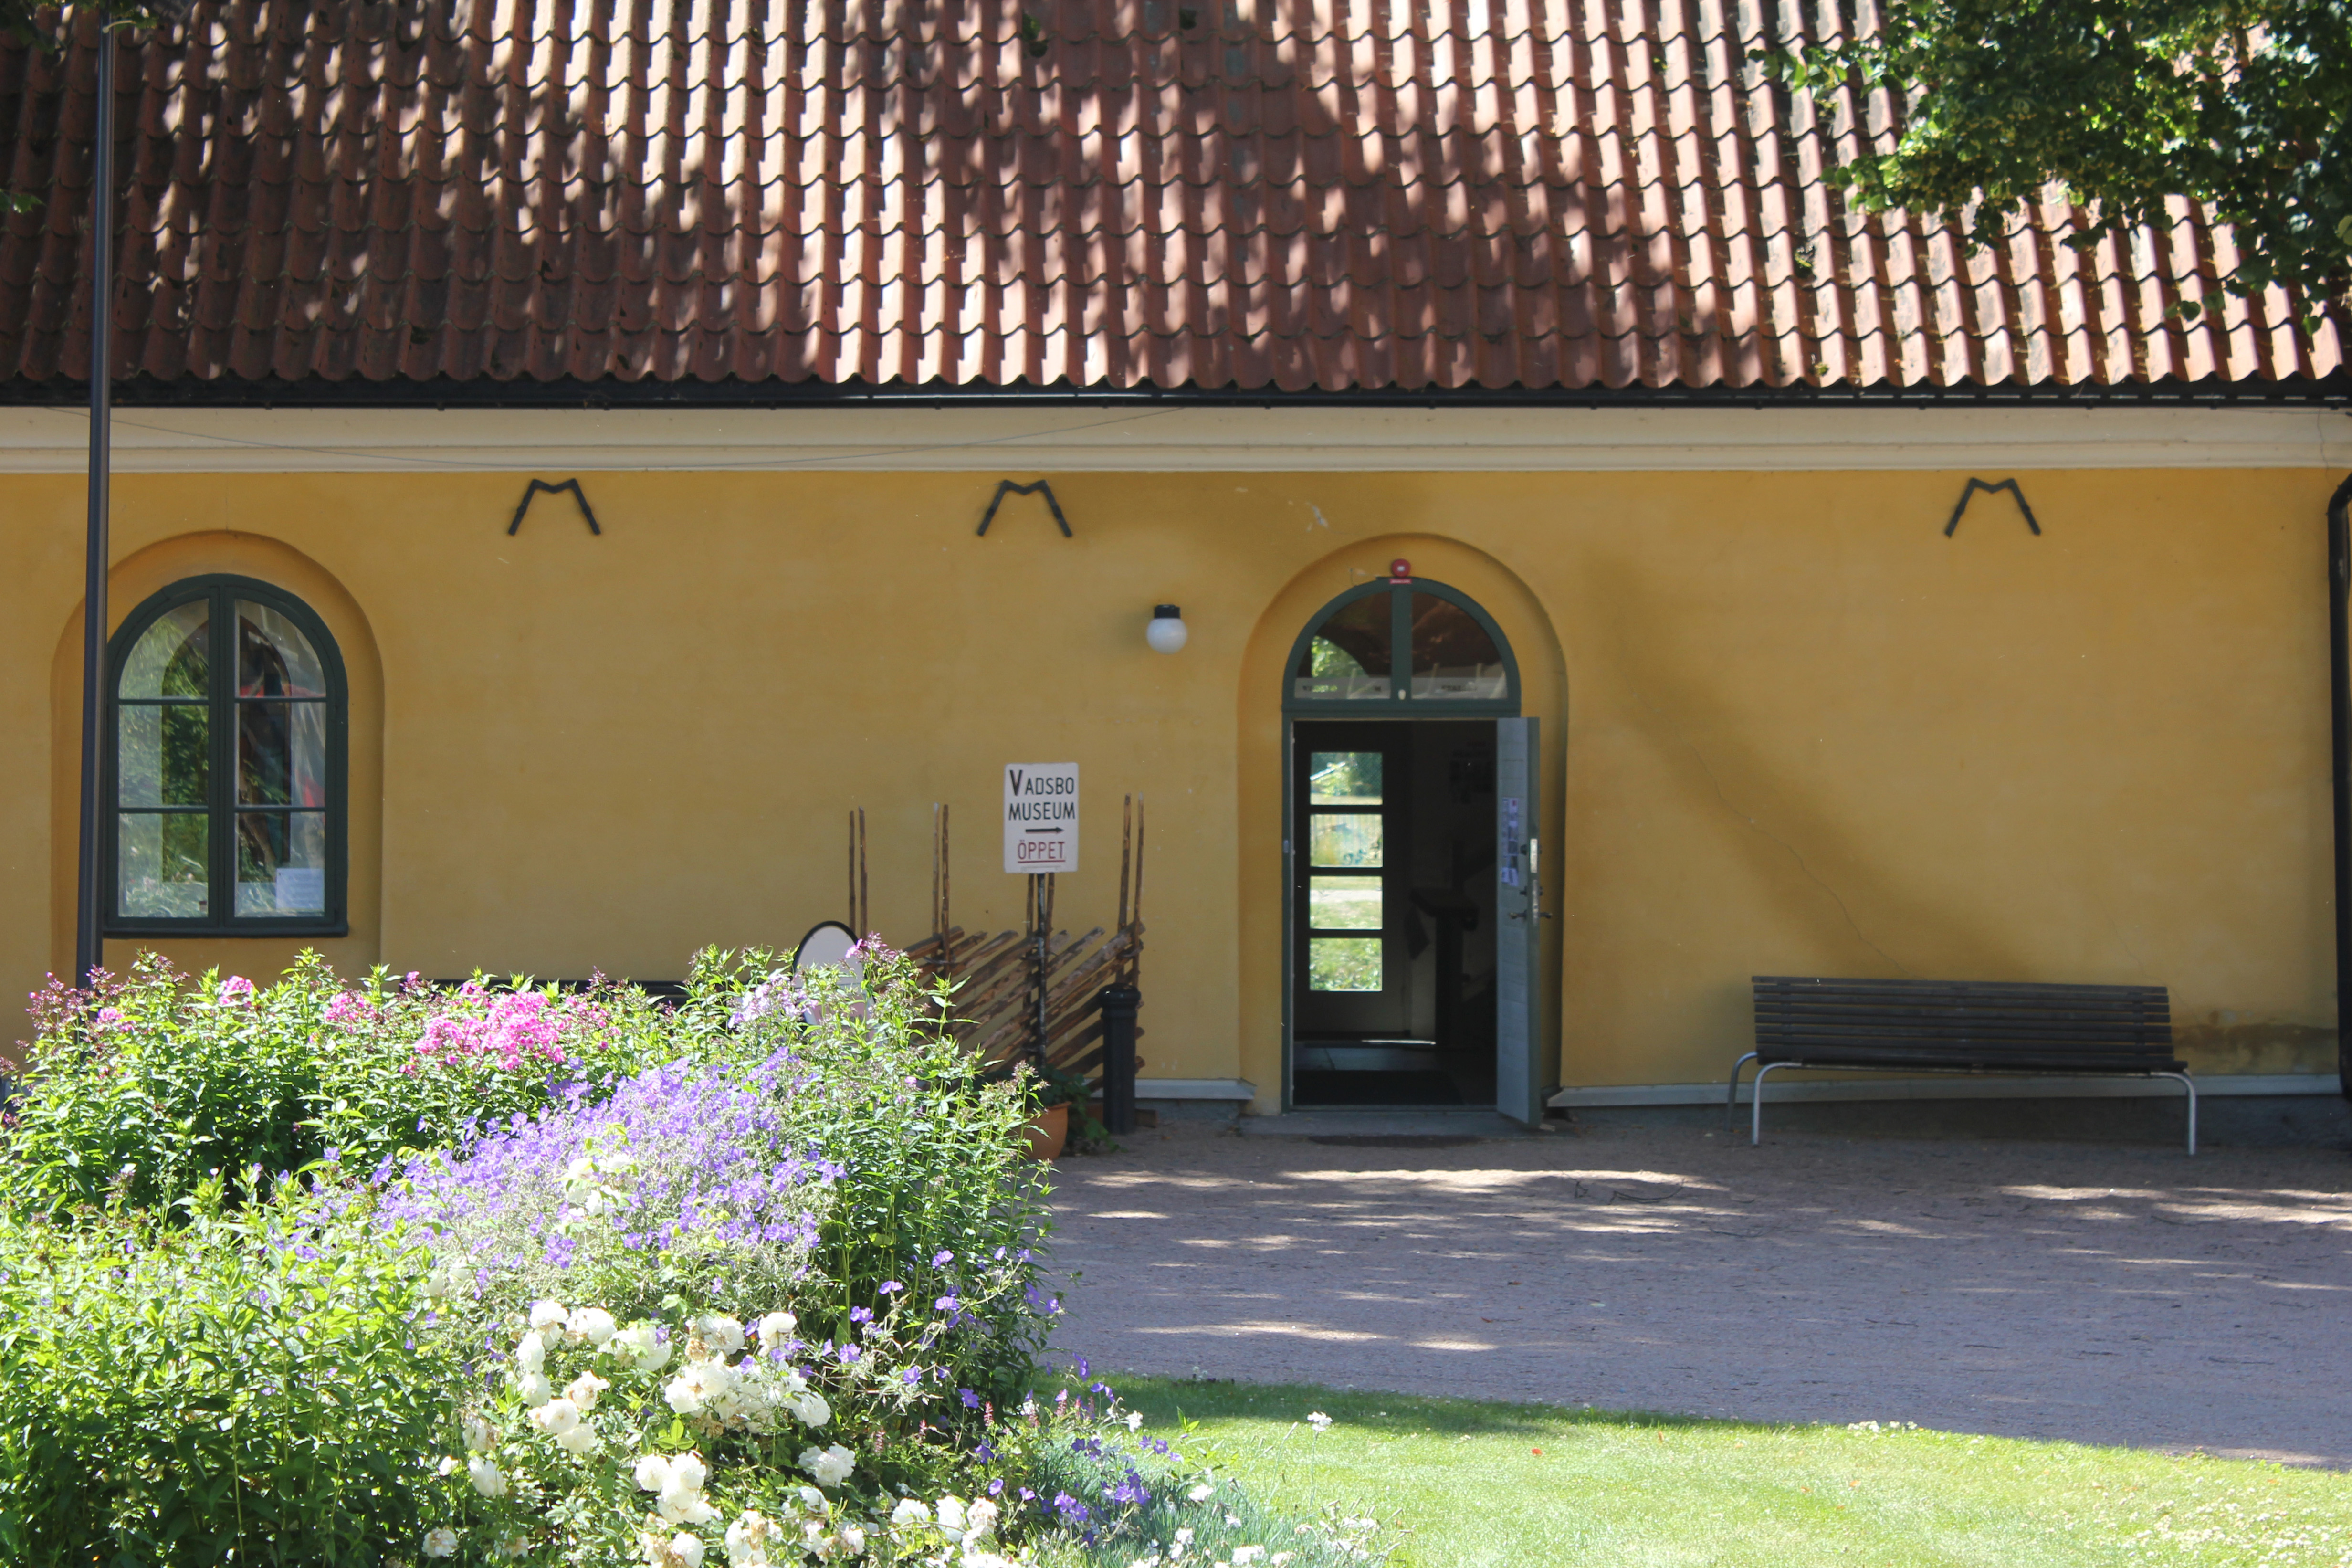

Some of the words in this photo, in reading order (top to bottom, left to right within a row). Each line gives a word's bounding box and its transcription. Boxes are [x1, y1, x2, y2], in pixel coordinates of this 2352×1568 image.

[1009, 769, 1074, 796] VADSBO
[1008, 802, 1076, 821] MUSEUM
[1018, 839, 1065, 860] ÖPPET
